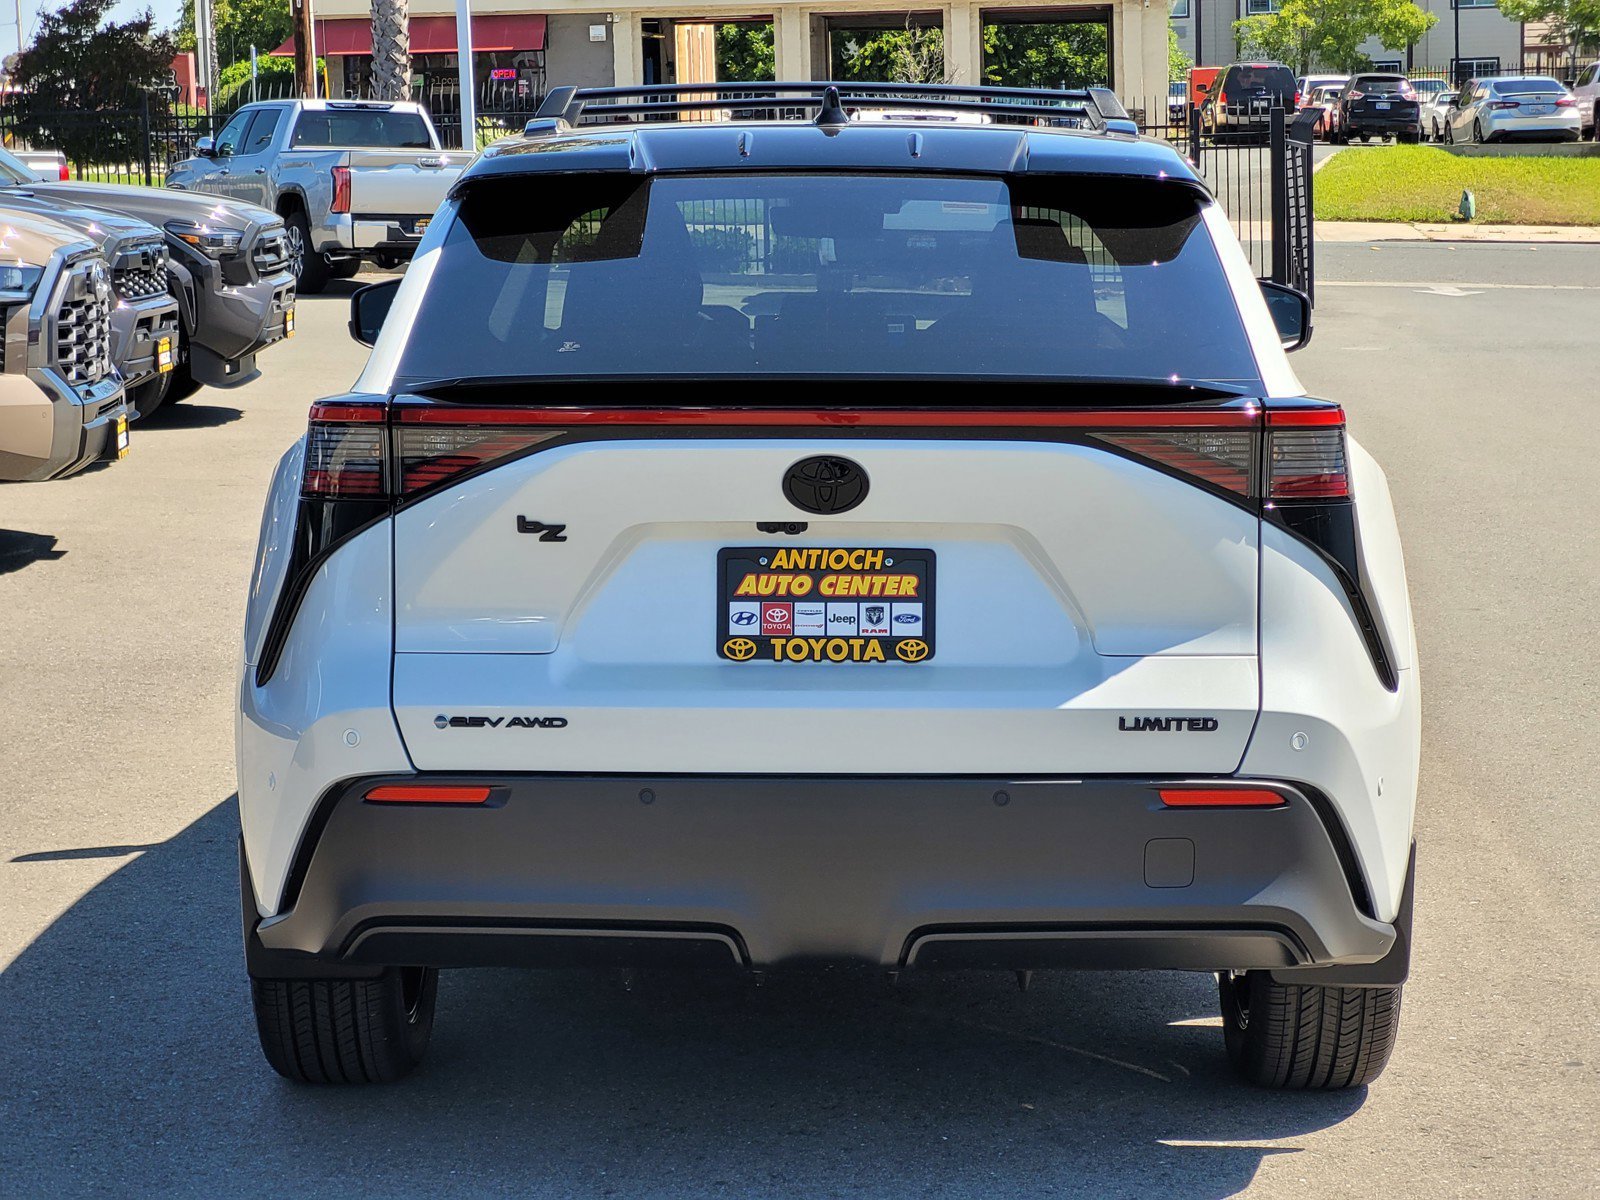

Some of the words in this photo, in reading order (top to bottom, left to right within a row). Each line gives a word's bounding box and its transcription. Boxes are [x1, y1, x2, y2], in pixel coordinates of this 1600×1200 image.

[493, 69, 516, 79] OPEN
[769, 549, 884, 570] ANTIOCH
[734, 573, 814, 597] AUTO
[818, 574, 919, 597] CENTER
[828, 613, 857, 626] Jeep
[897, 614, 916, 623] Ford
[770, 639, 886, 661] TOYOTA
[505, 716, 568, 728] AWD
[1118, 716, 1218, 731] LIMITED
